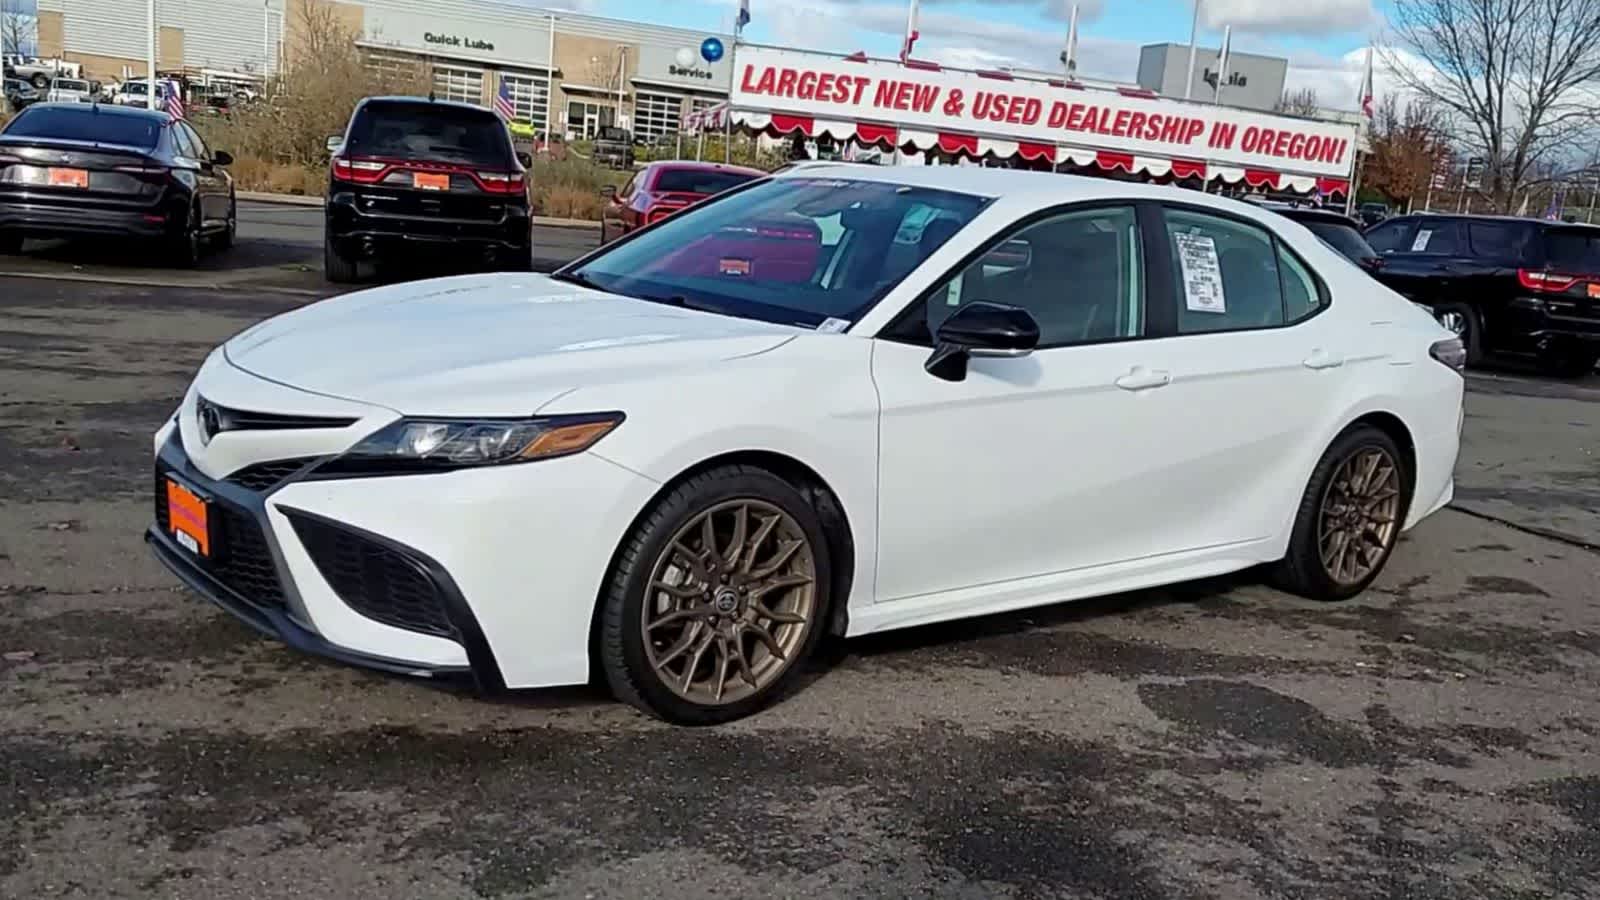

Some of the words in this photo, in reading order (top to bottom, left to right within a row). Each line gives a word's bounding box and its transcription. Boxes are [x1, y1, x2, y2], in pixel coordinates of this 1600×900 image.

[424, 32, 460, 46] Quick
[464, 37, 495, 51] Lube
[669, 64, 713, 80] Service
[1203, 67, 1247, 88] Lia
[740, 64, 871, 106] LARGEST
[873, 79, 941, 113] NEW
[943, 89, 965, 117] &
[972, 91, 1042, 126] USED
[1047, 101, 1205, 146] DEALERSHIP
[1207, 122, 1237, 150] IN
[1241, 126, 1348, 165] OREGON!
